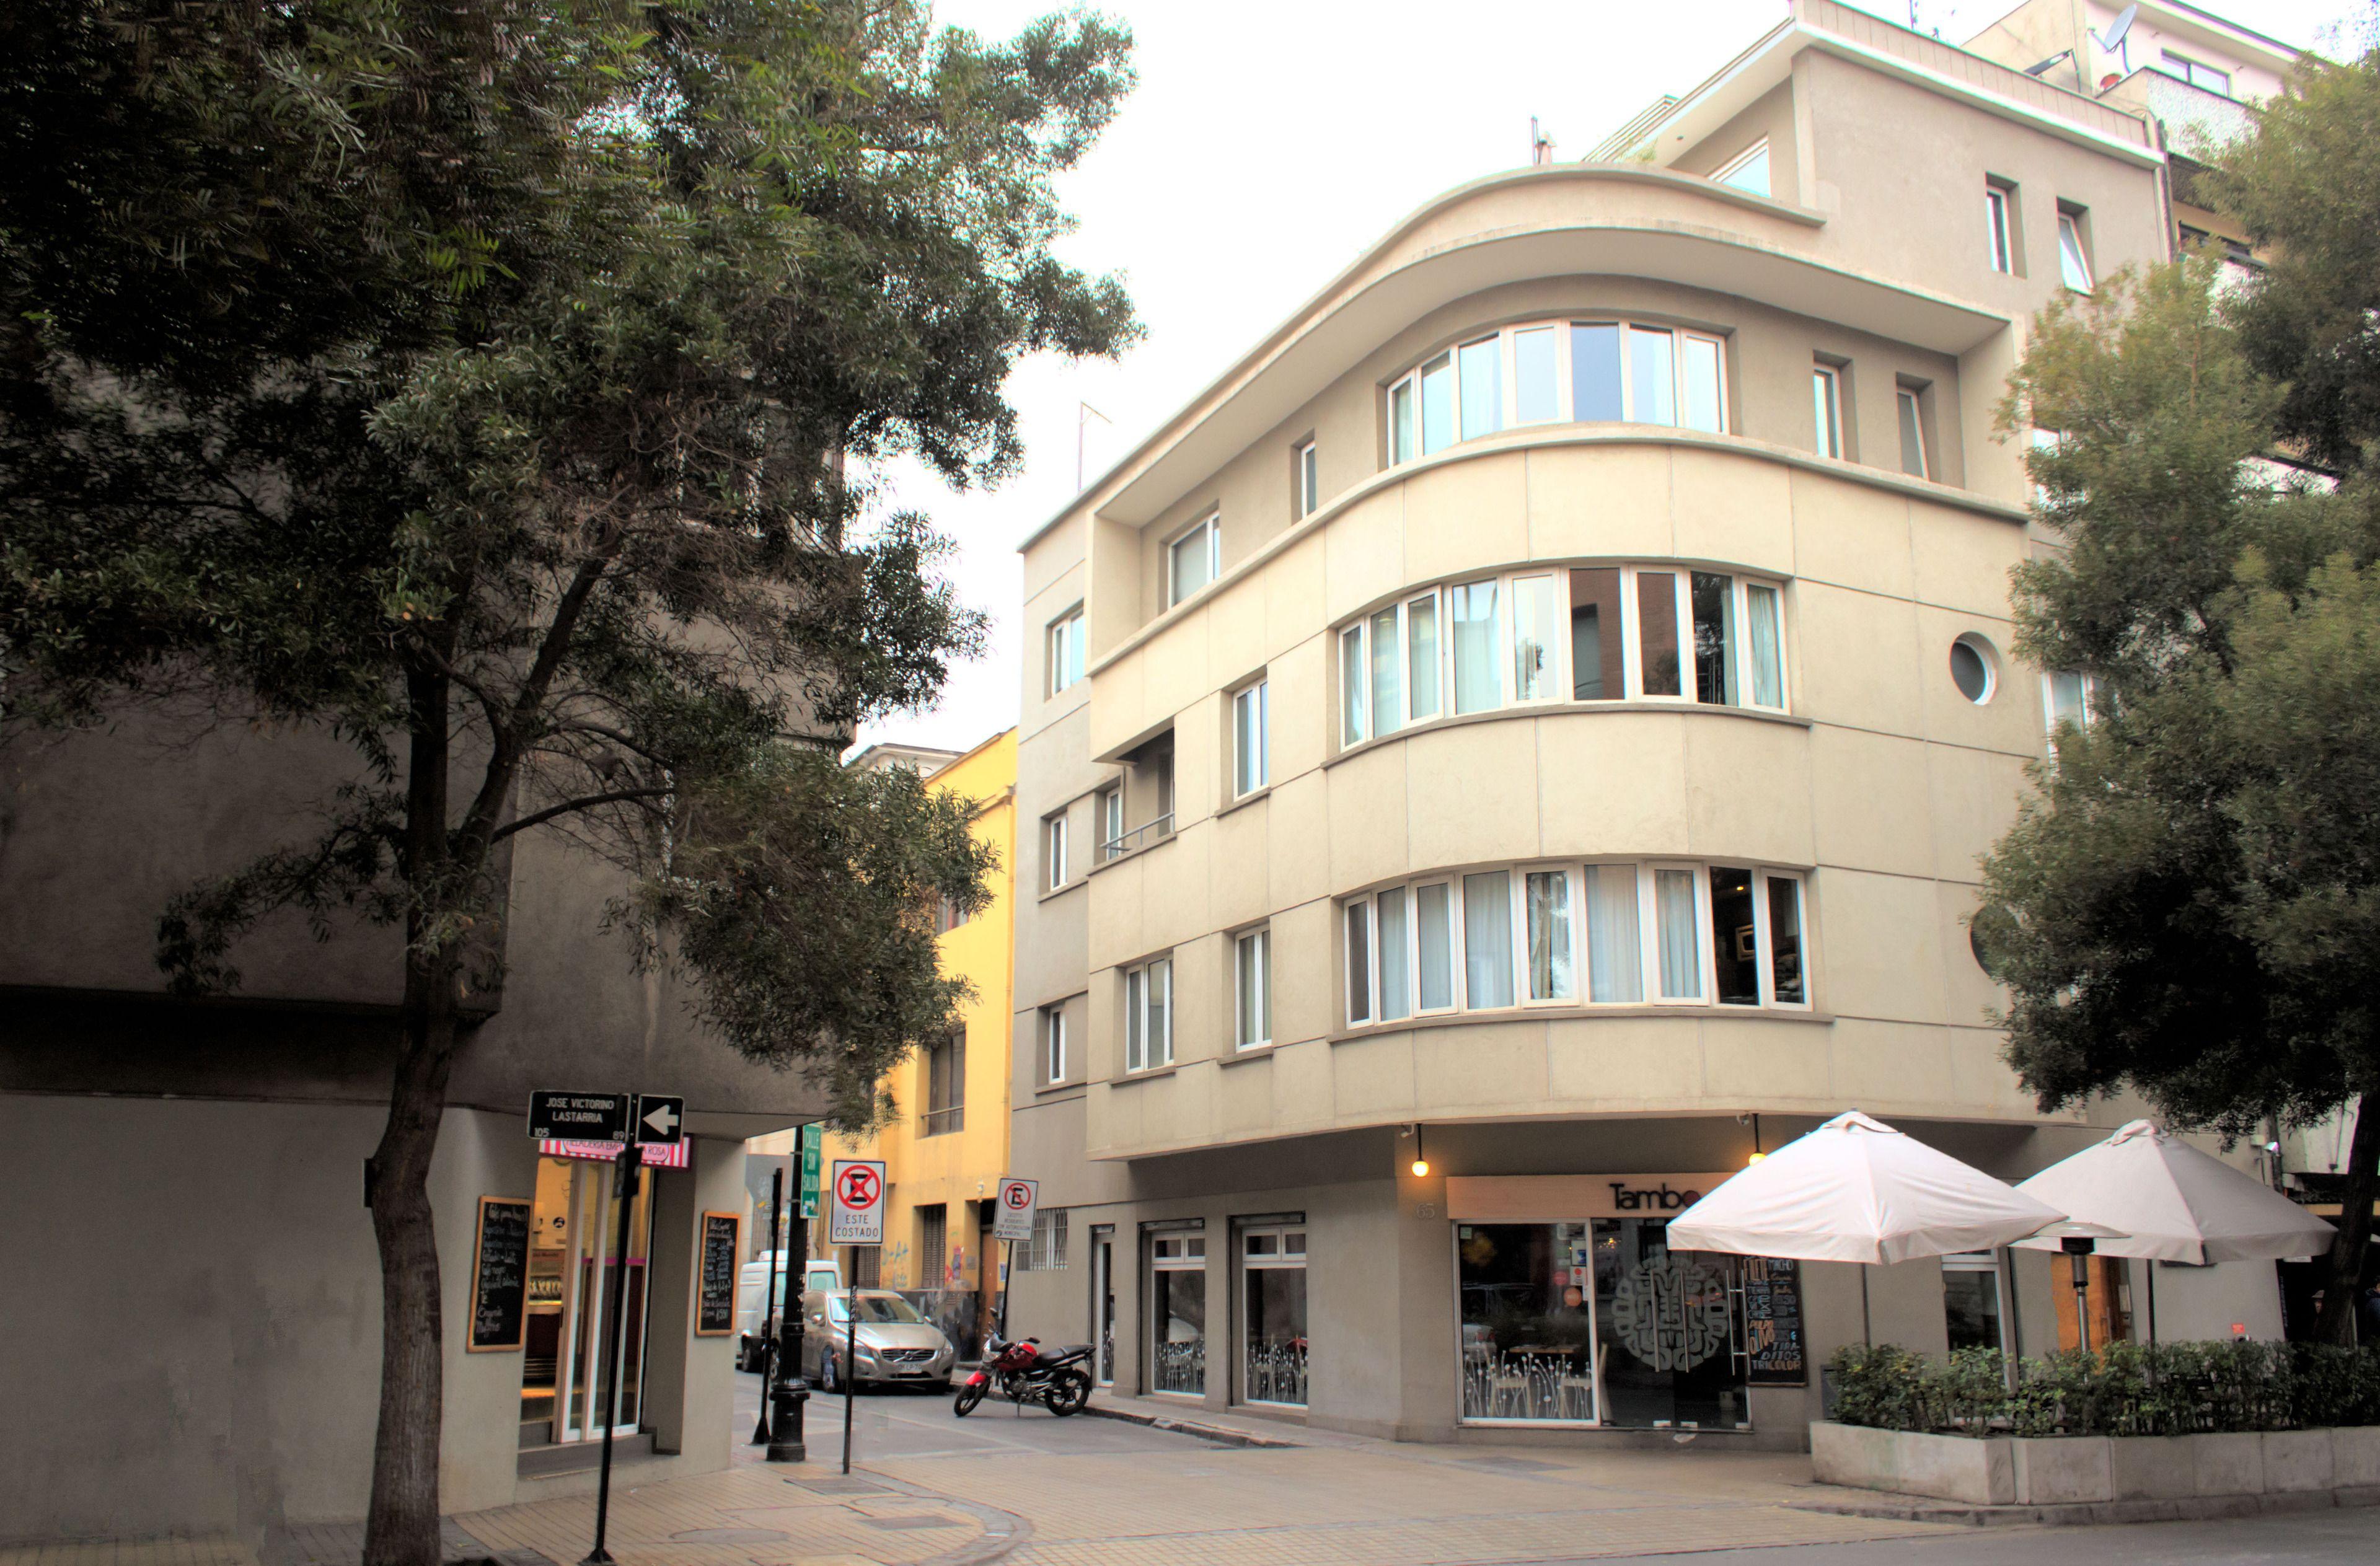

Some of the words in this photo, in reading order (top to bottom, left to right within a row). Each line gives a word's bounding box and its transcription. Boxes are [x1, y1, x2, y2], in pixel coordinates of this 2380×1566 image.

[546, 1097, 568, 1108] JOSE
[571, 1098, 615, 1110] VICTORINO
[552, 1111, 603, 1124] LASTARRIA
[534, 1127, 550, 1138] 105
[612, 1130, 625, 1140] 89
[806, 1131, 819, 1150] CALLE
[648, 1145, 666, 1156] ROSA
[803, 1173, 819, 1192] SALIDA
[845, 1214, 869, 1225] ESTE
[835, 1227, 879, 1238] COSTADO
[1752, 1359, 1801, 1371] TRICOLOR
